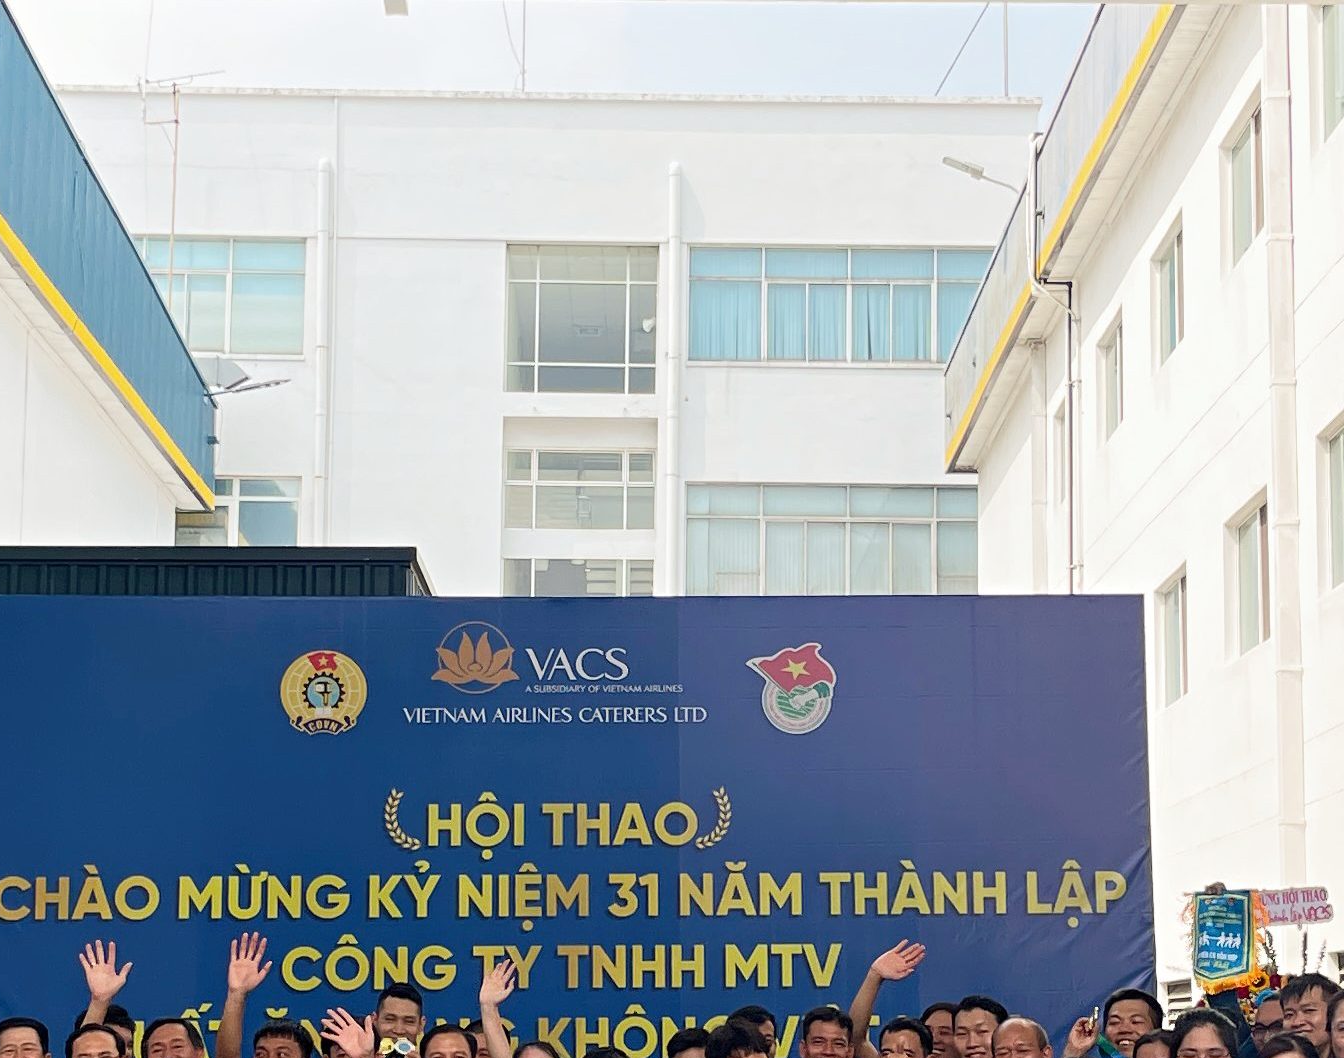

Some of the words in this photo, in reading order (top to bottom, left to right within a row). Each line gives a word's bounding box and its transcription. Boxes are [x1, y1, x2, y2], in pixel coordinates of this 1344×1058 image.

[525, 647, 629, 681] VACS
[534, 684, 586, 693] SUBSIDIARY
[587, 684, 599, 693] OF
[602, 684, 642, 693] VIETNAM
[643, 684, 684, 693] AIRLINES
[403, 706, 487, 724] VIETNAM
[492, 706, 573, 724] AIRLINES
[578, 706, 668, 723] CATERERS
[674, 706, 708, 723] LTD
[428, 792, 525, 860] HỘI
[542, 801, 699, 847] THAO
[178, 863, 350, 920] MỪNG
[369, 860, 441, 919] KỶ
[458, 862, 590, 931] NIỆM
[608, 872, 659, 917] 31
[679, 862, 803, 916] NĂM
[819, 859, 1008, 915] THÀNH
[1026, 859, 1127, 928] LẬP
[281, 934, 458, 992] CÔNG
[472, 944, 543, 990] TY
[558, 944, 706, 989] TNHH
[725, 943, 842, 988] MTV
